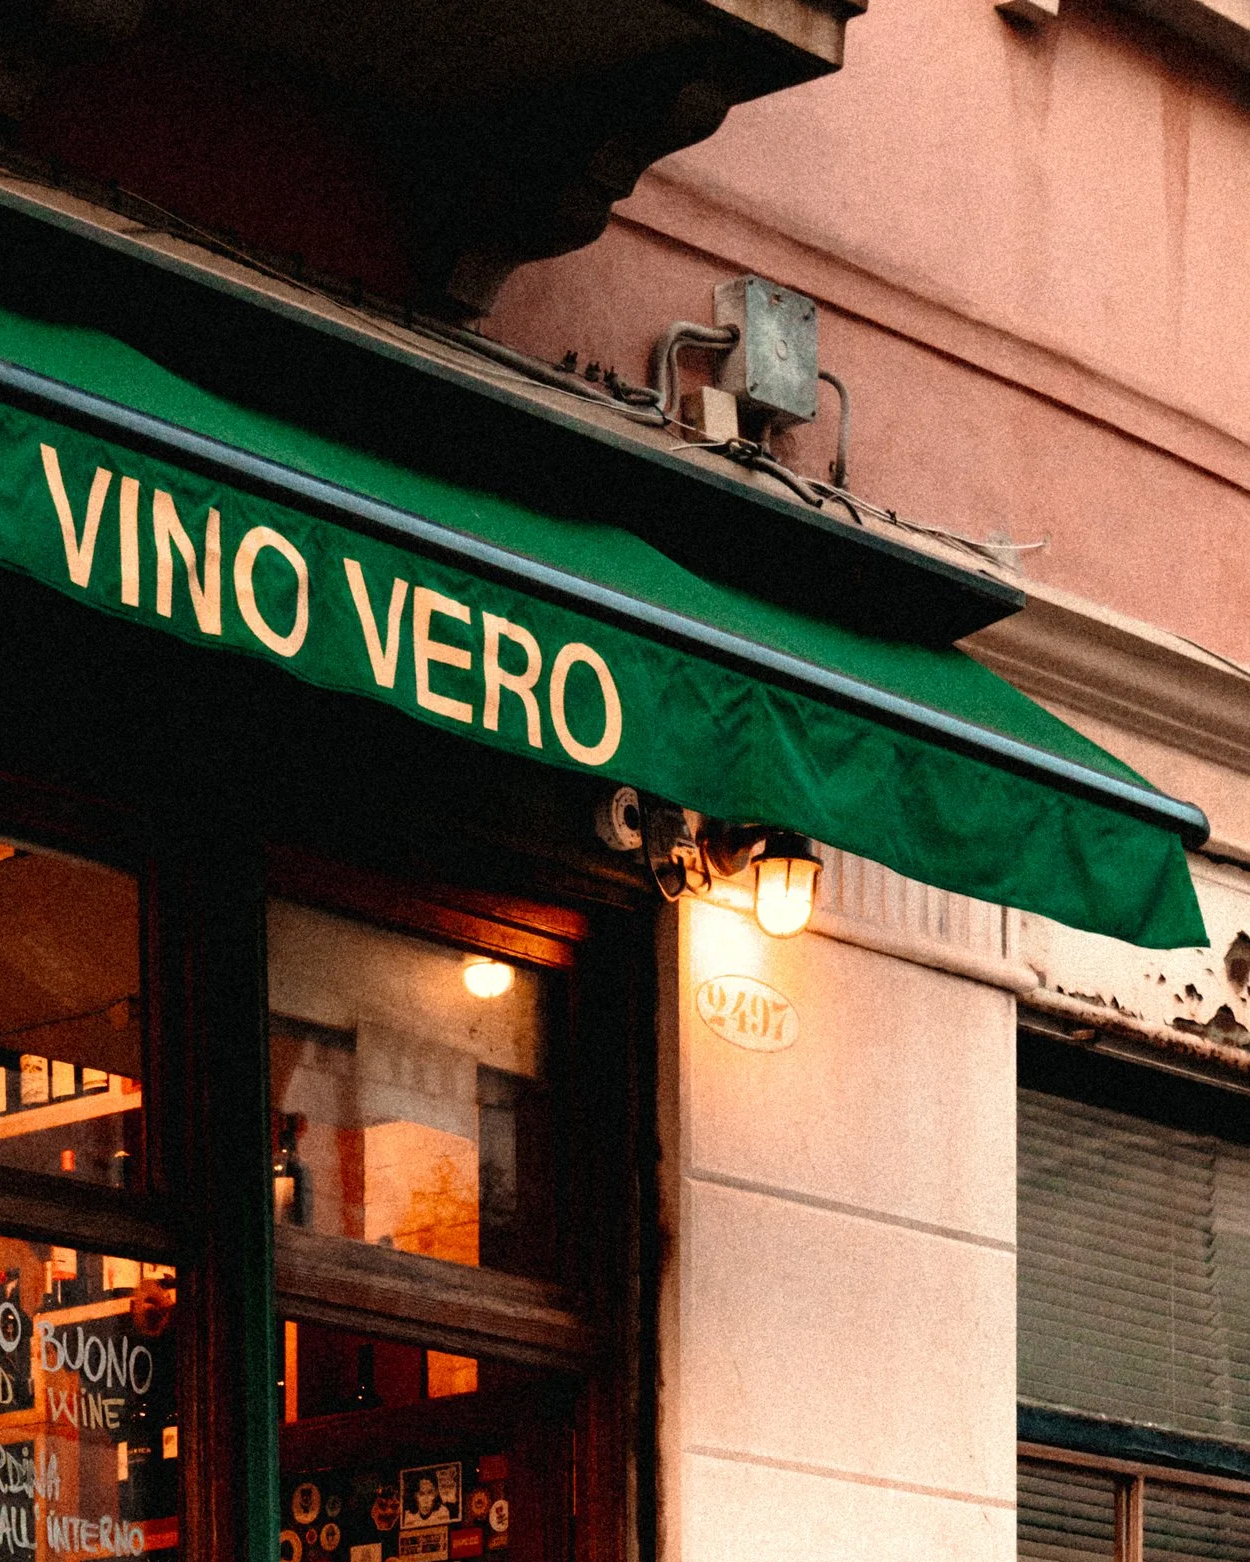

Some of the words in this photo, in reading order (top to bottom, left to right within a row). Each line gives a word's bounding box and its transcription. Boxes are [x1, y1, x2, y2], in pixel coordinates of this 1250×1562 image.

[40, 442, 309, 658] VINO
[343, 557, 623, 766] VERO
[707, 984, 789, 1041] 2497
[37, 1320, 153, 1395] BUONO
